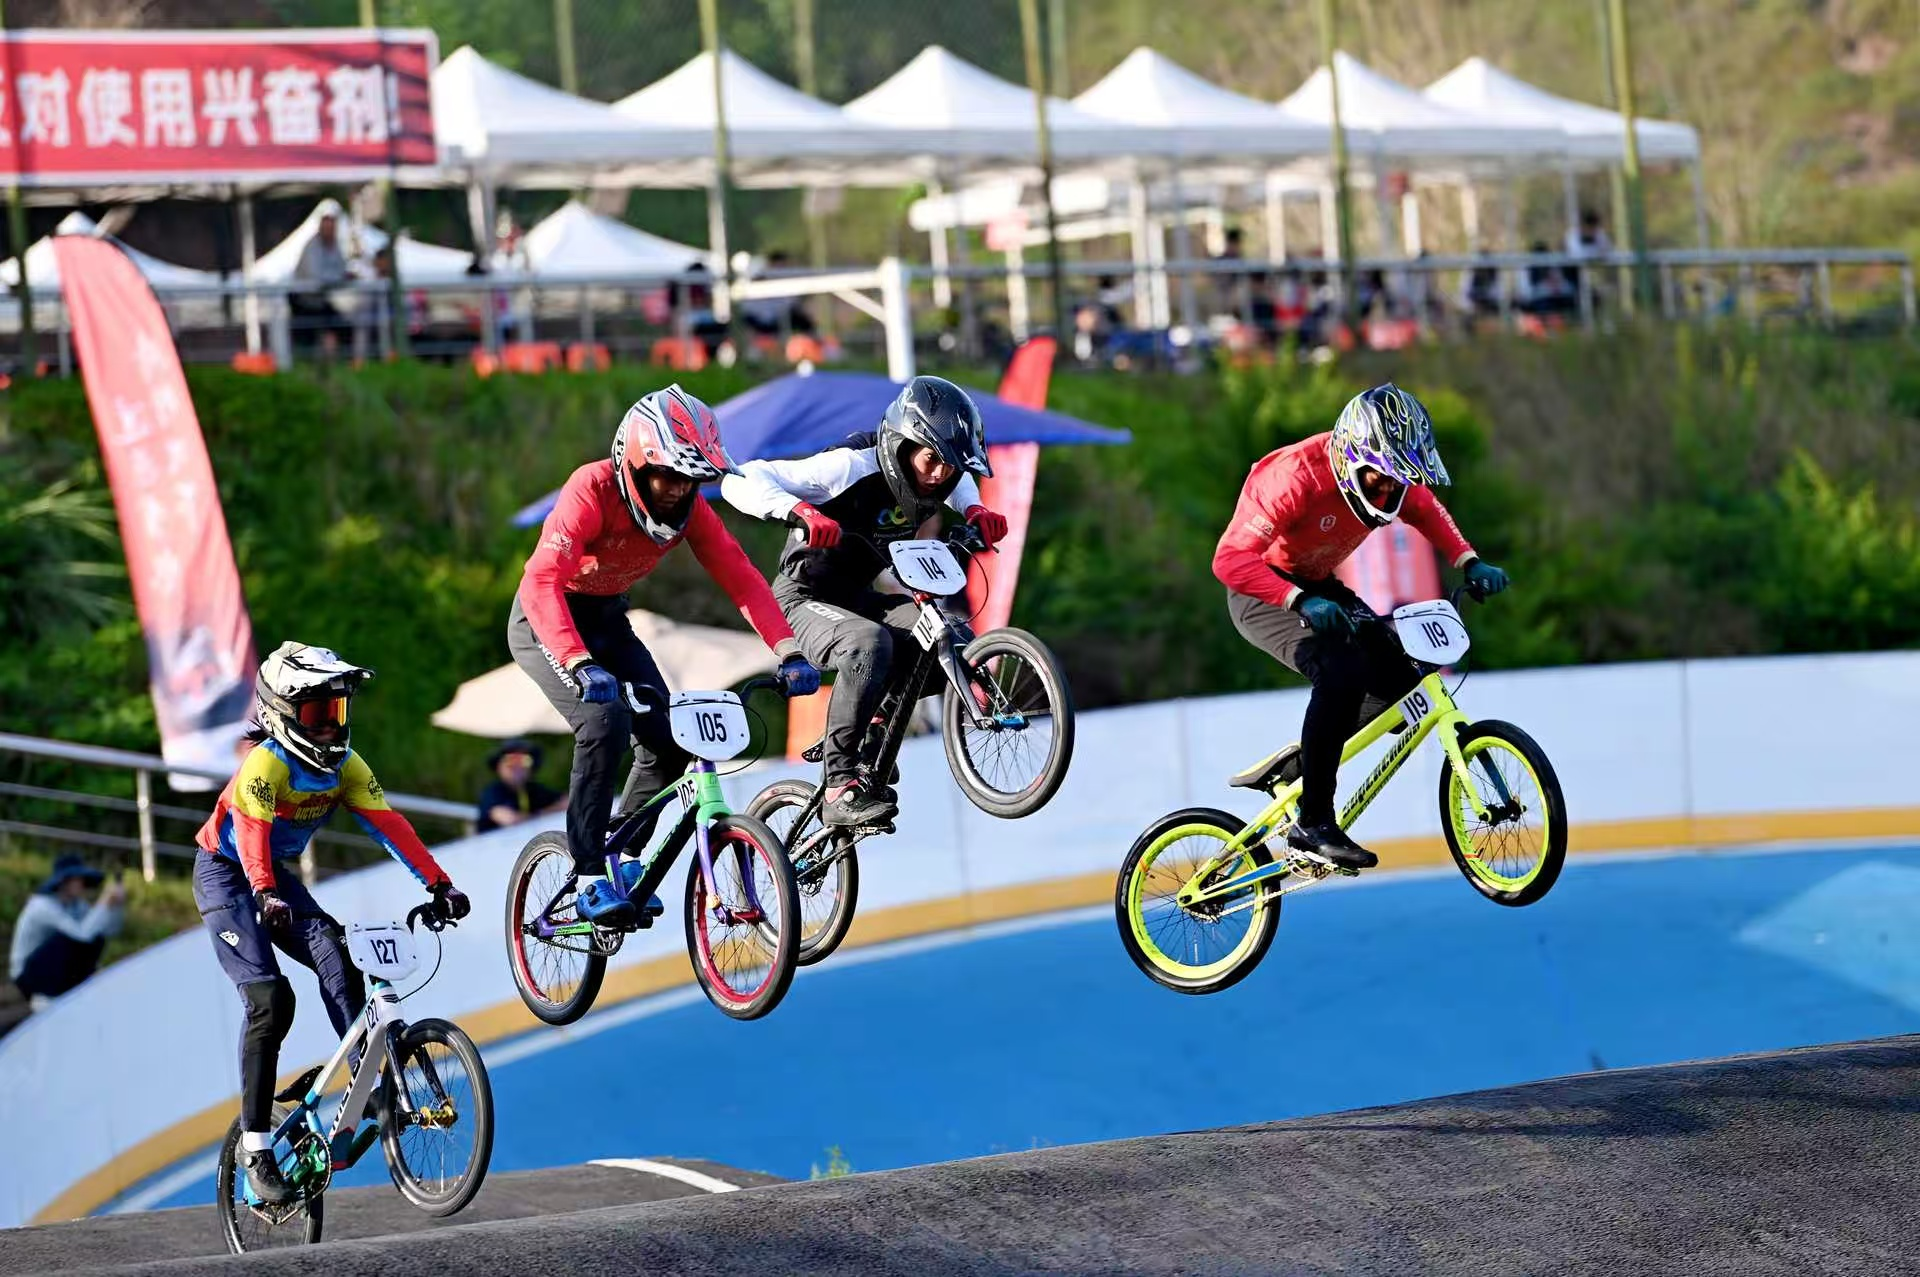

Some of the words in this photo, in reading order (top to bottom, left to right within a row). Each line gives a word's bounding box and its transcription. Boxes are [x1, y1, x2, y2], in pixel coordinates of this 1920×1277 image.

[0, 65, 399, 148] 对使用兴奋剂!
[916, 556, 947, 580] 114
[917, 612, 935, 644] 114
[1421, 620, 1450, 649] 119
[1403, 691, 1430, 722] 119
[695, 711, 728, 743] 105
[677, 779, 696, 810] 105
[370, 938, 399, 965] 127
[365, 997, 379, 1033] 127
